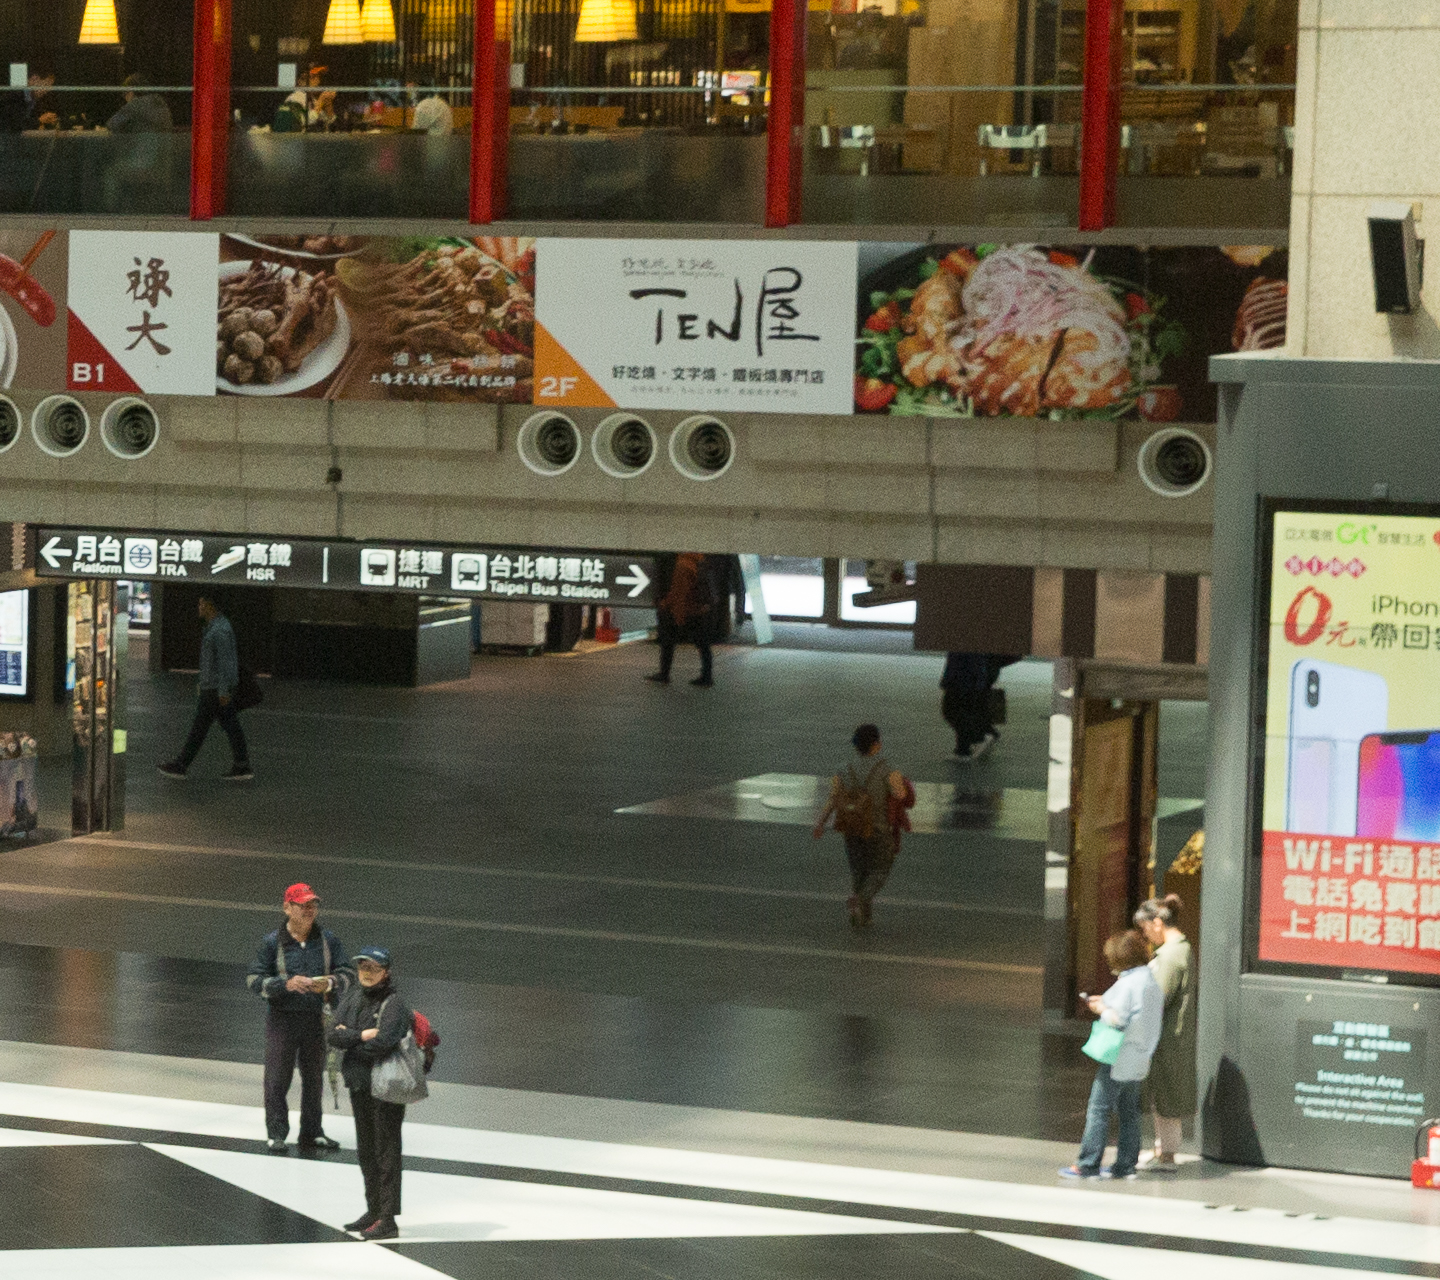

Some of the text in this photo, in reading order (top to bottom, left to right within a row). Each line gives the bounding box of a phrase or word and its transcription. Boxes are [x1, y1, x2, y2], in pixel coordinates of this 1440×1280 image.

[72, 363, 105, 383] B1
[540, 377, 578, 398] 2F
[75, 535, 606, 585] 月台 台鐵 高鐵 捷運 台北轉運站
[72, 560, 610, 599] Platform TRA HSR MRT Taipei Bus Station
[1372, 594, 1440, 616] iPhon
[1371, 622, 1440, 651] 帶回
